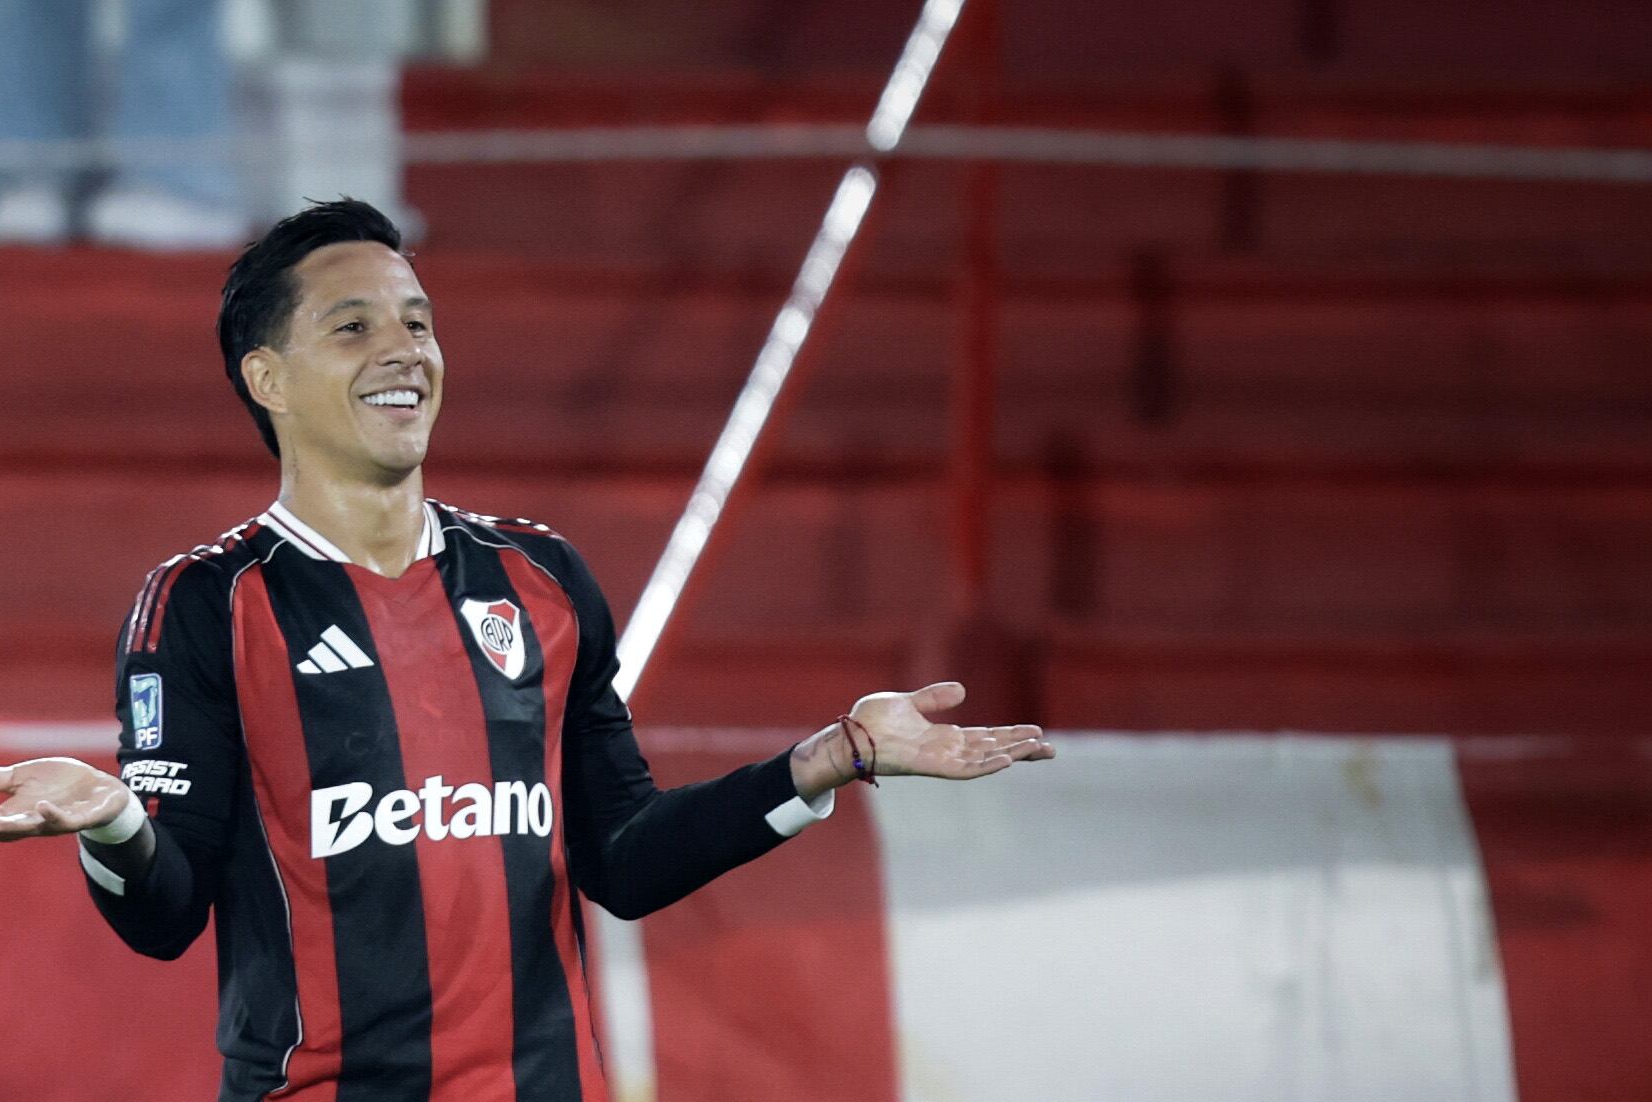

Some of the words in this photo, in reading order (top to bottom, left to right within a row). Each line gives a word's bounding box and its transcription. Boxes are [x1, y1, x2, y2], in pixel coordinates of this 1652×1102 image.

[136, 726, 158, 747] PF
[121, 759, 188, 780] ASSIST
[129, 776, 192, 796] CARD
[310, 774, 554, 860] Betano
